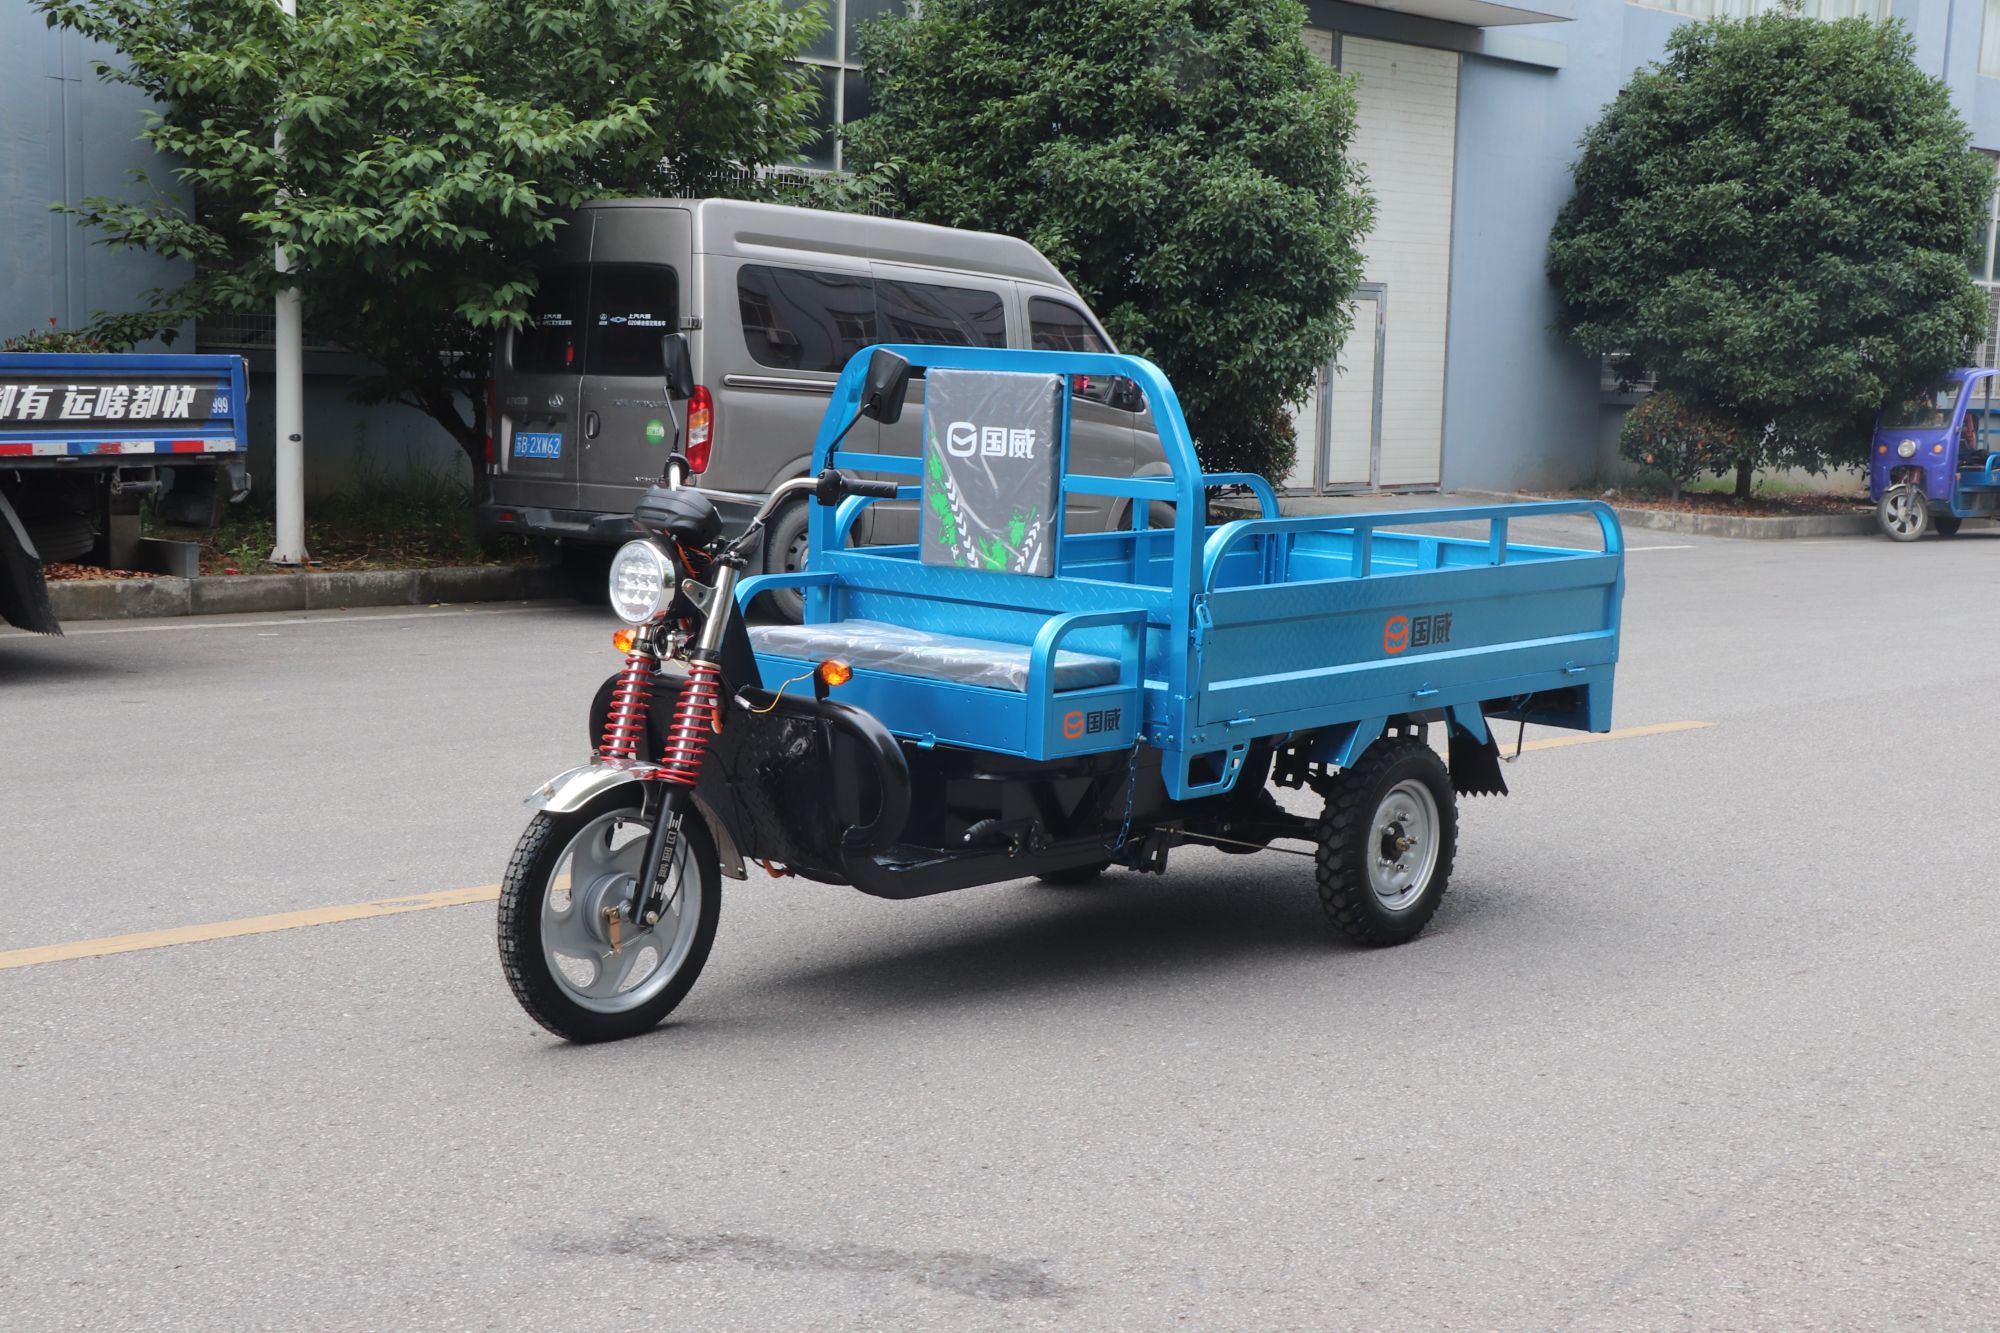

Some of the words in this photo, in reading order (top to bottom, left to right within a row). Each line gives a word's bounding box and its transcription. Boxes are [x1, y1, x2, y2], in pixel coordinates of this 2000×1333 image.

[59, 384, 197, 419] 运啥都快
[981, 426, 1036, 459] 国威
[1410, 611, 1453, 648] 国威
[1086, 708, 1121, 734] 国威
